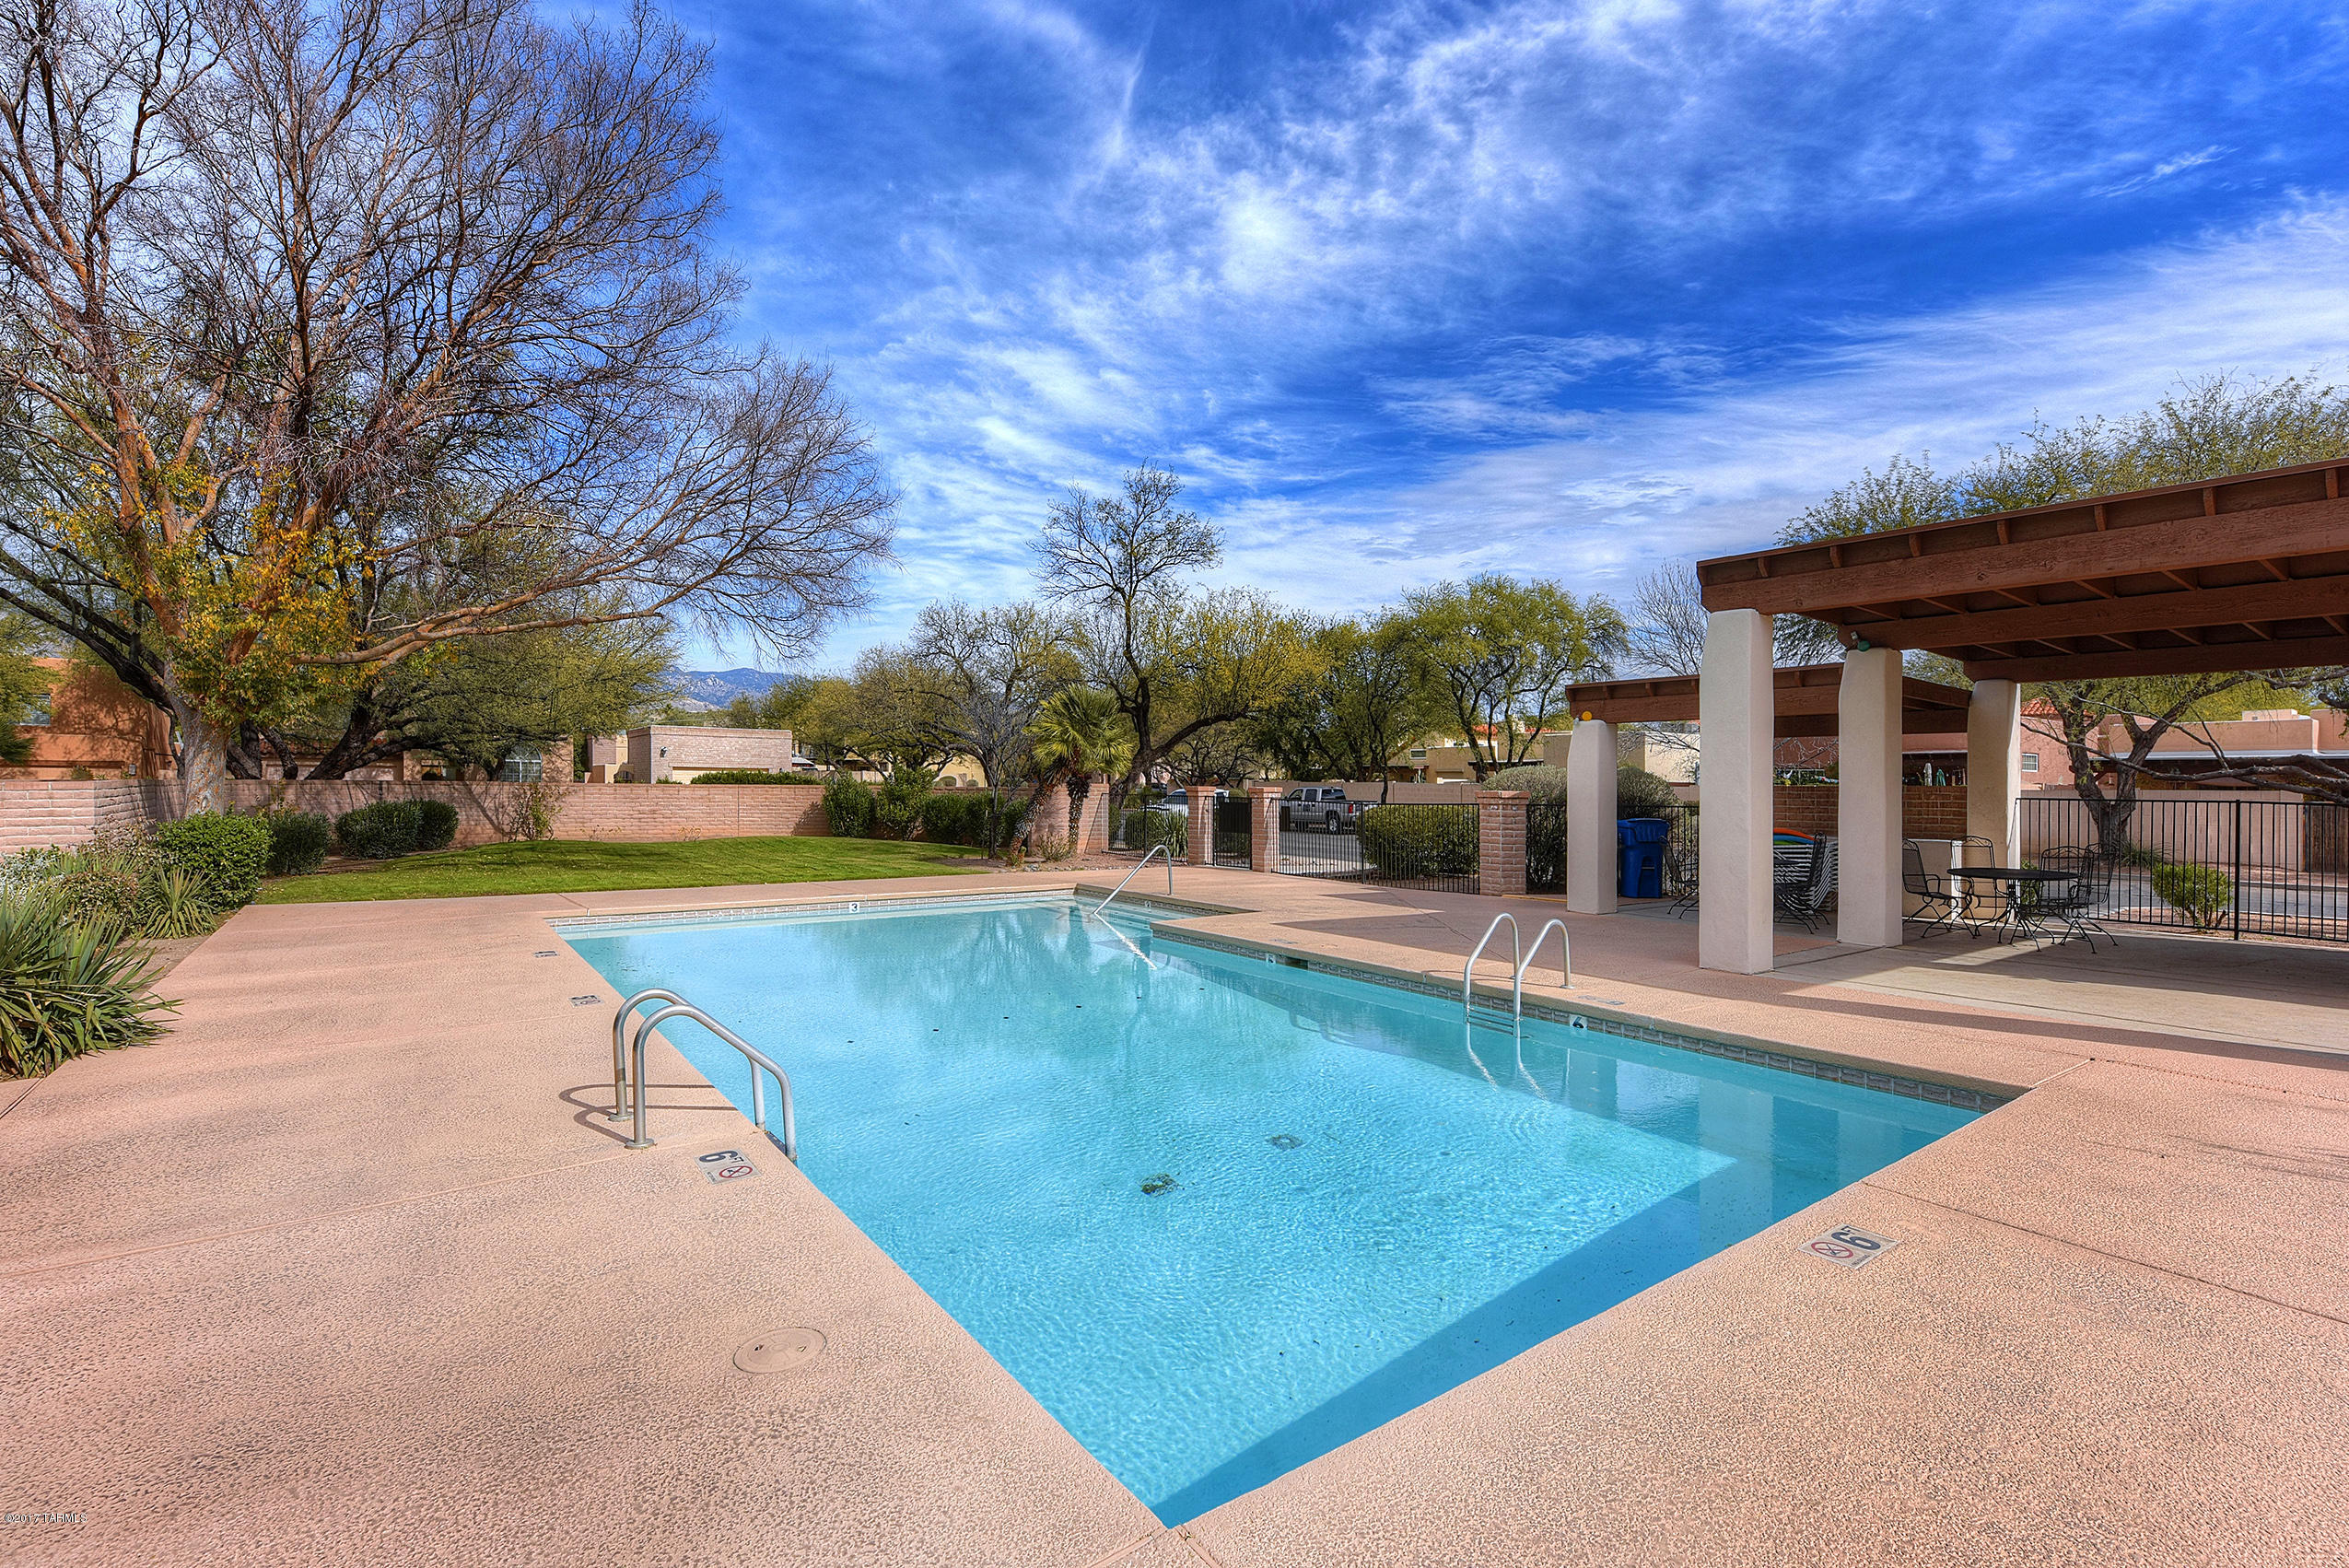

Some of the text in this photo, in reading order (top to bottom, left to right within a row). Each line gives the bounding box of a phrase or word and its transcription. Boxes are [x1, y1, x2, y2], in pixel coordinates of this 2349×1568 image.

[851, 903, 859, 912] 3
[699, 1150, 738, 1163] 6
[1830, 1232, 1881, 1250] 6
